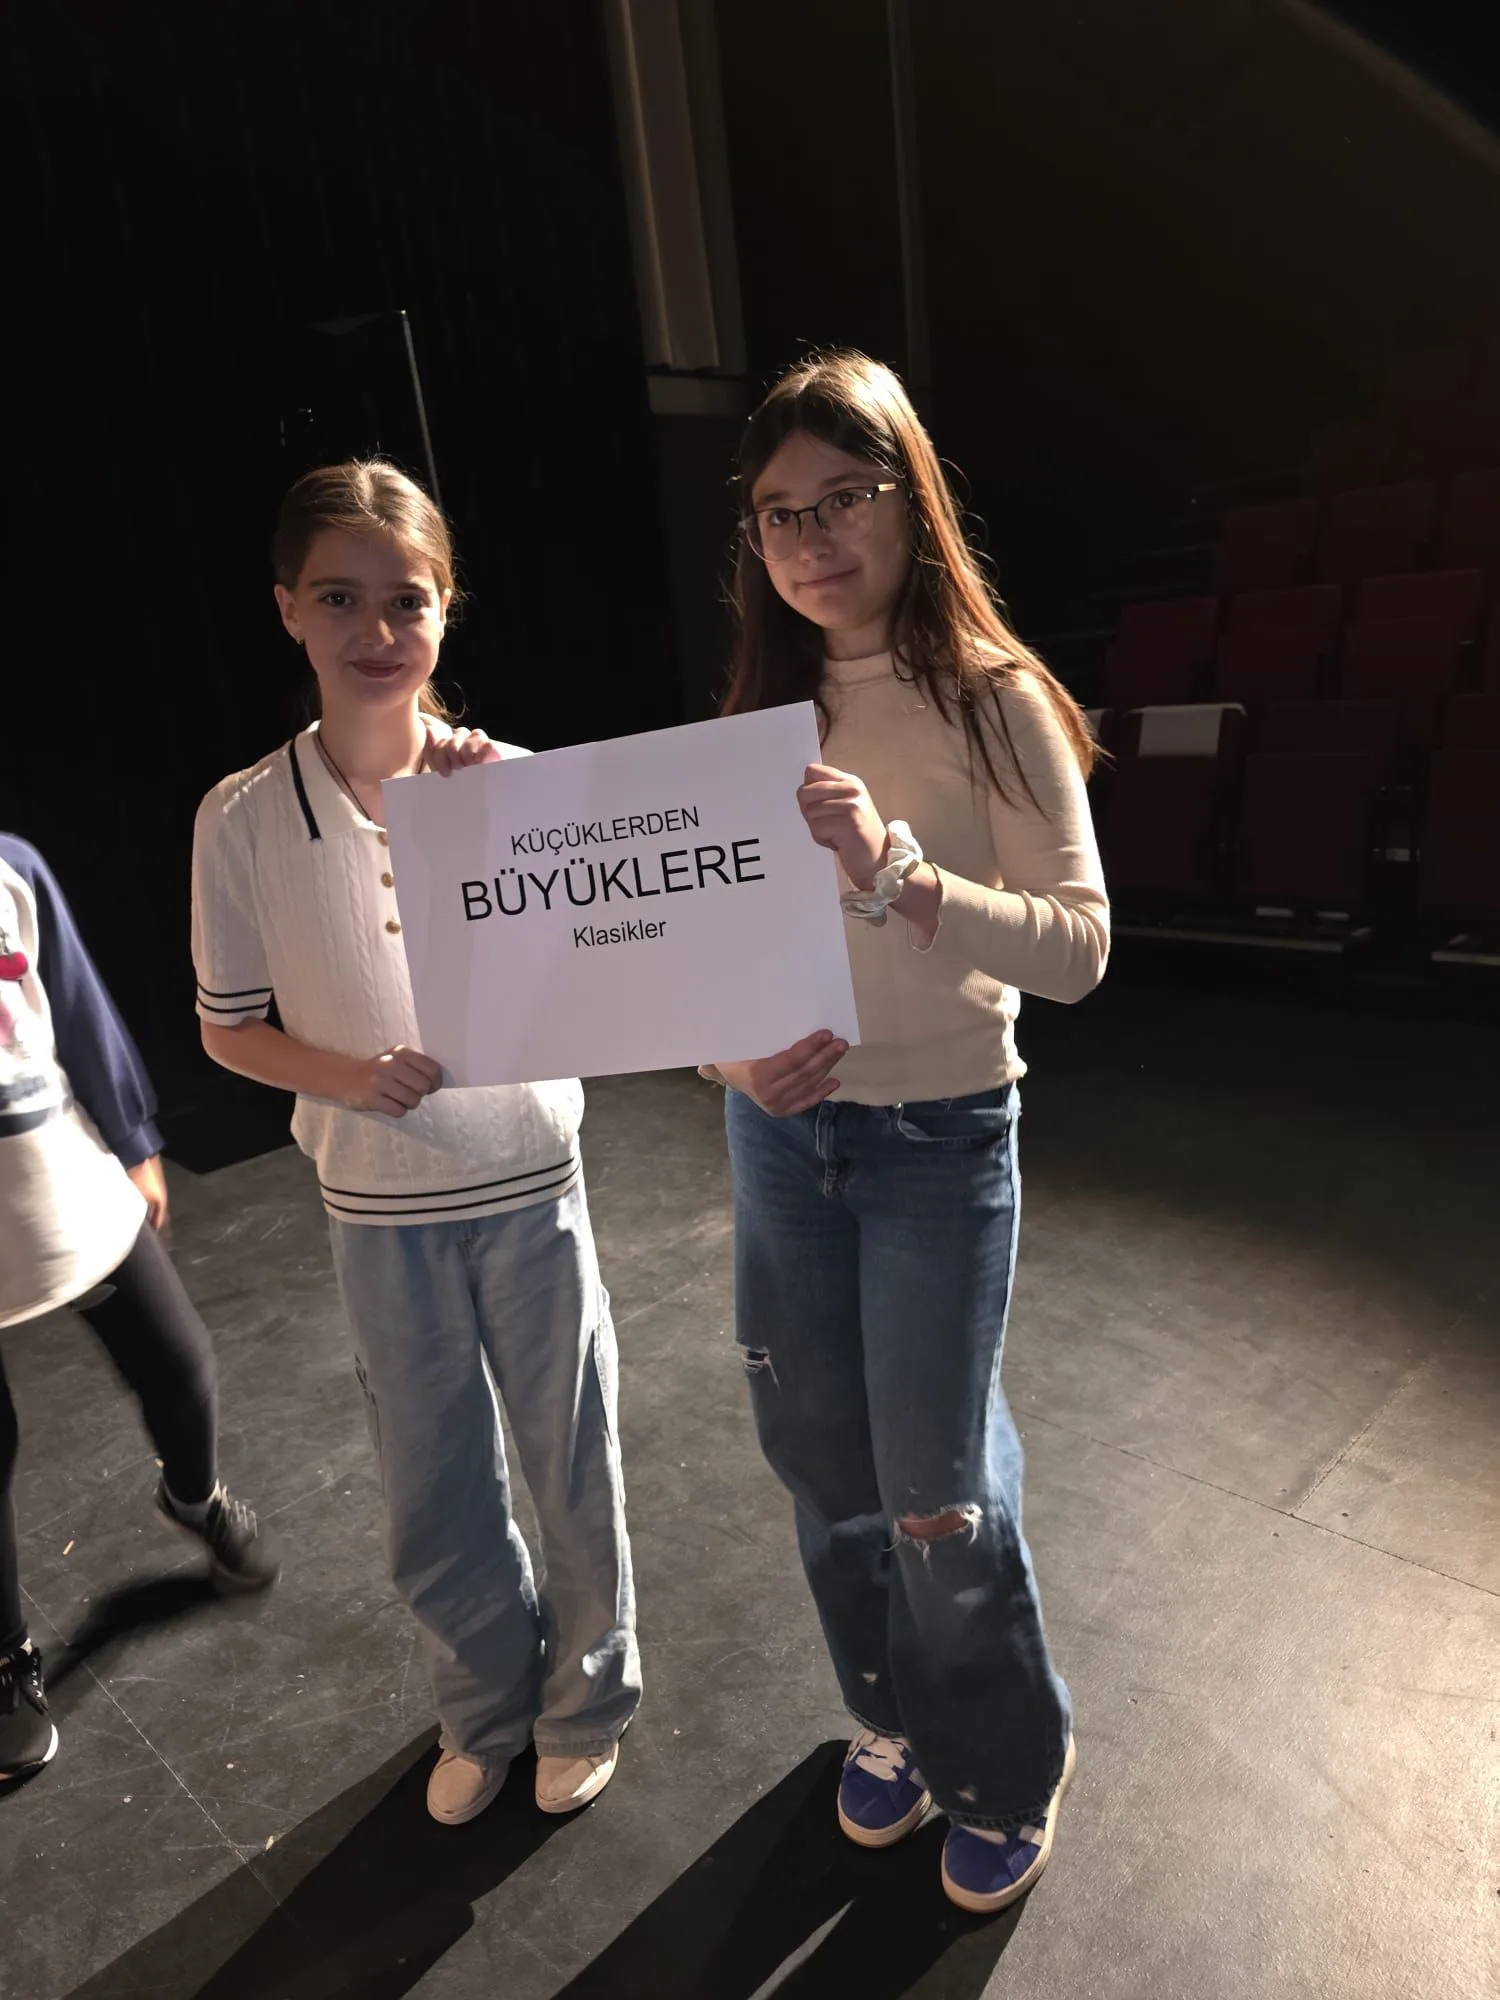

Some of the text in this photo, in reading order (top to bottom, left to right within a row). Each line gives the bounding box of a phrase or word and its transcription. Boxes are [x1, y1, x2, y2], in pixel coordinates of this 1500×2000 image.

[511, 806, 700, 855] KÜÇÜKLERDEN
[461, 838, 766, 921] BÜYÜKLERE
[573, 919, 667, 949] Klasikler
